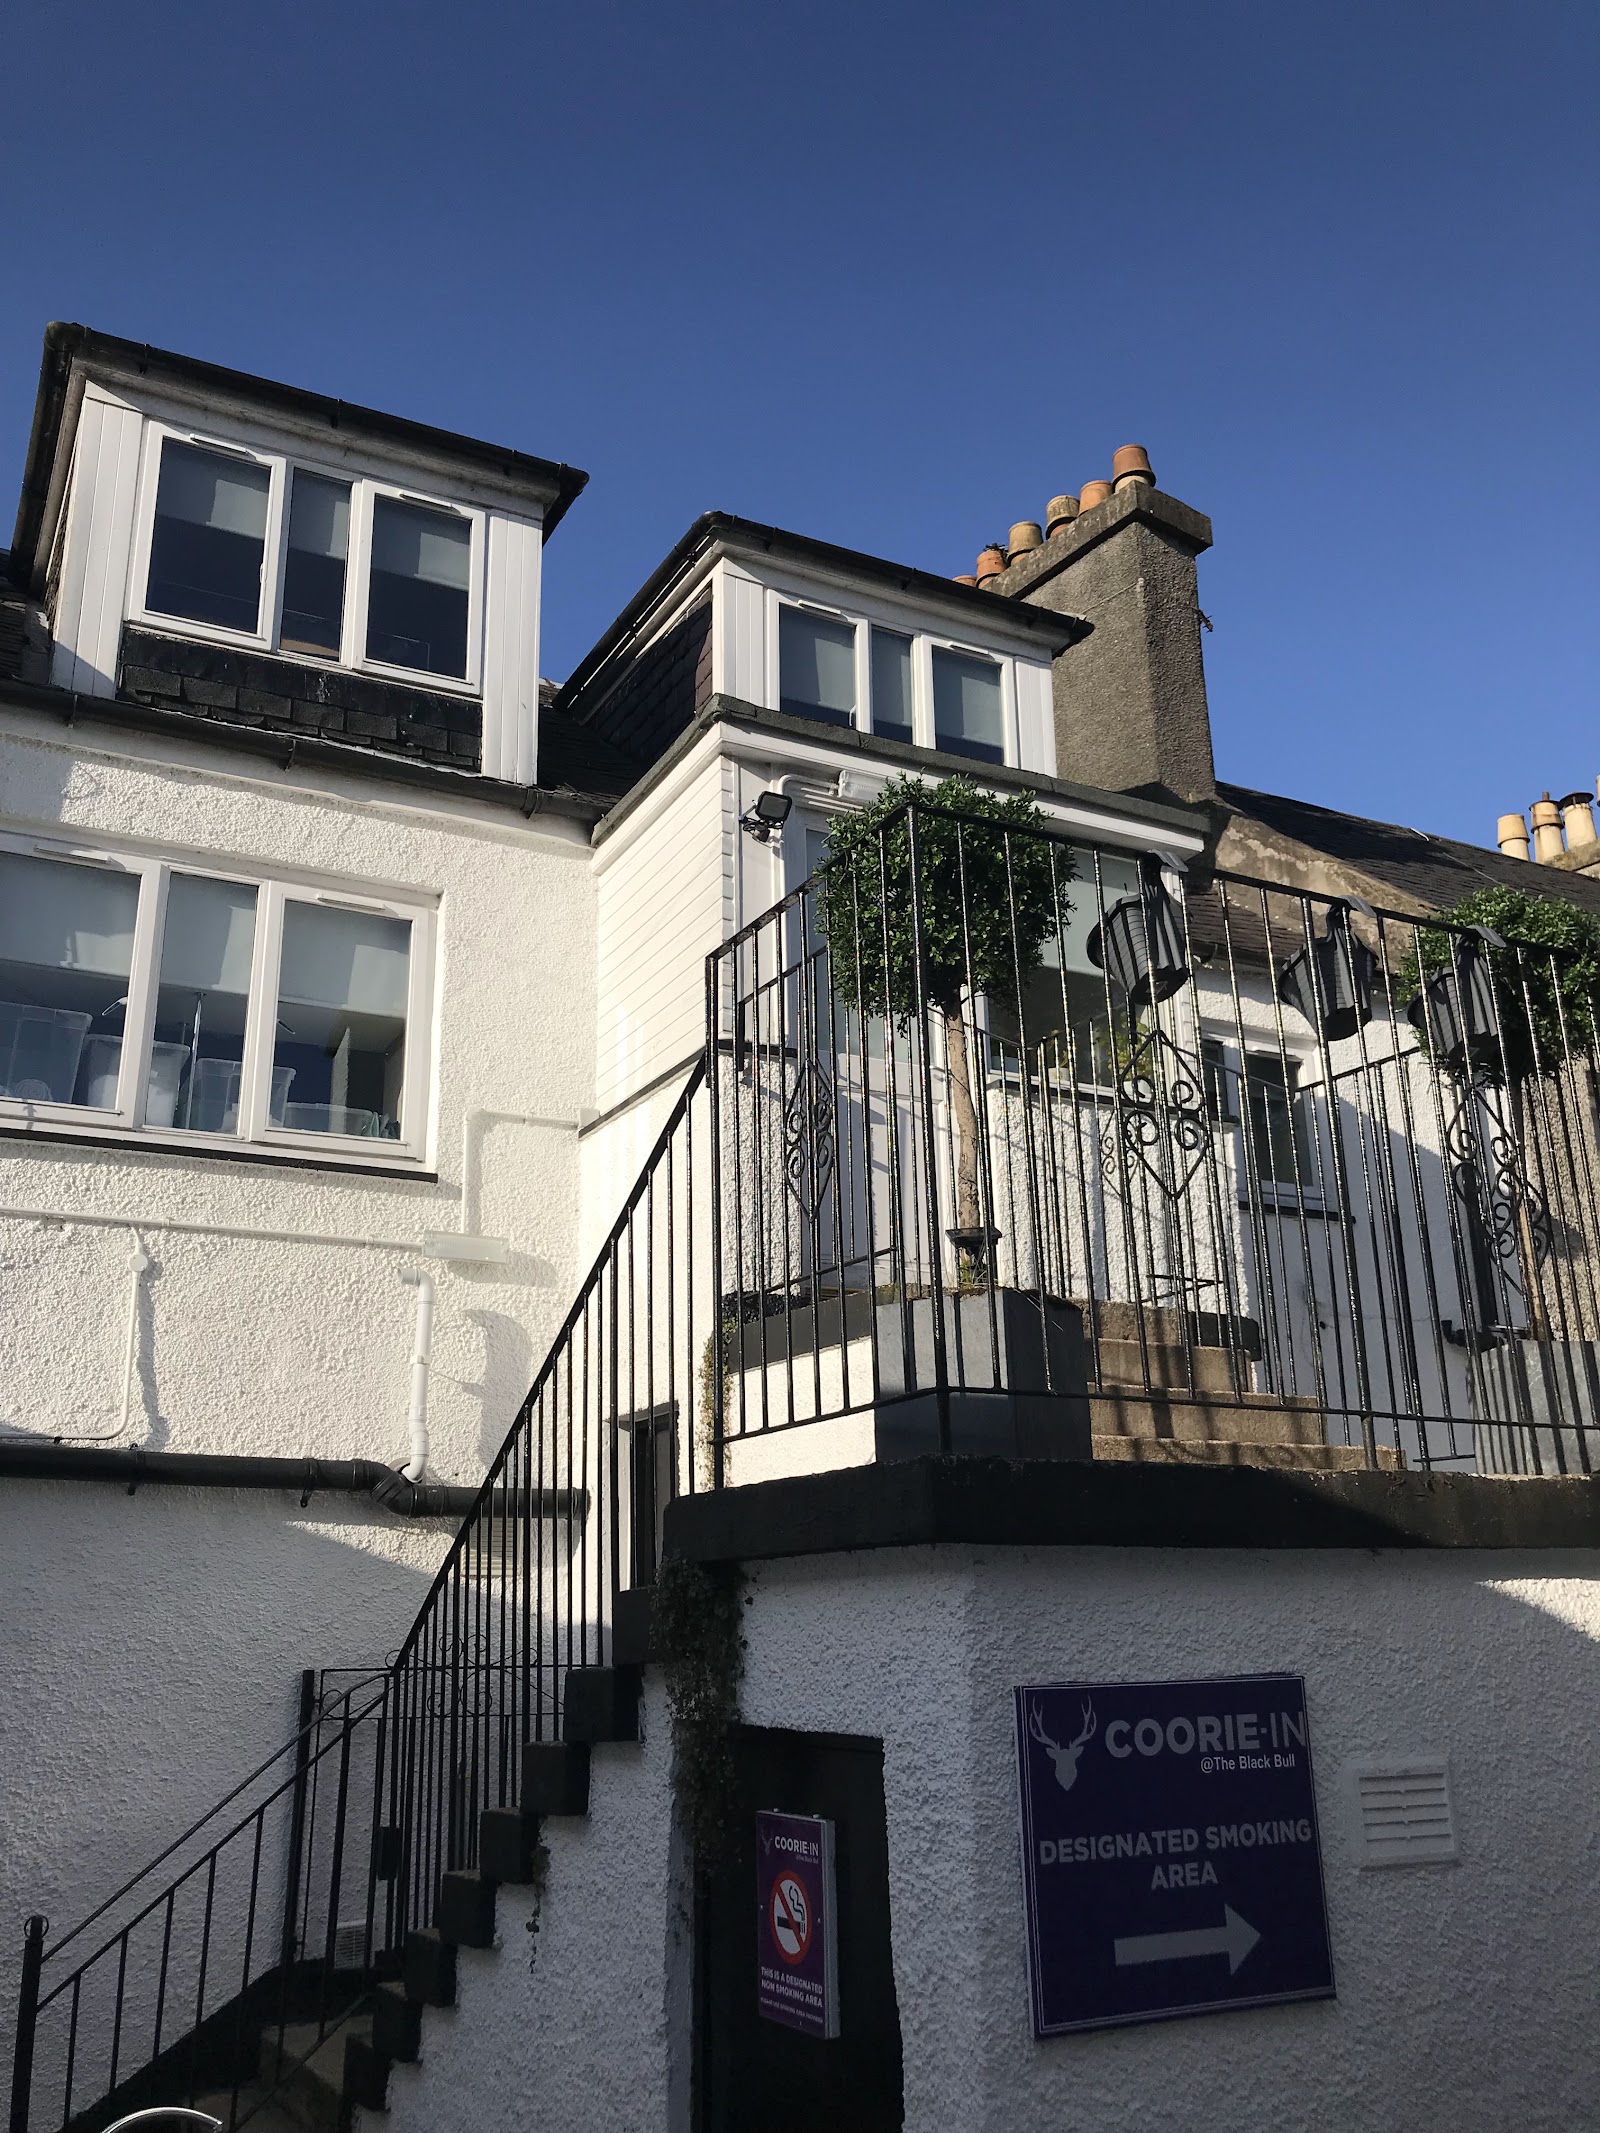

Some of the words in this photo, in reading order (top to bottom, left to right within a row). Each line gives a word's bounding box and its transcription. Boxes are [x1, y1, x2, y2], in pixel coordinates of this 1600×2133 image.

[1104, 1711, 1307, 1758] COORIE-IN
[1200, 1756, 1235, 1774] @The
[1239, 1754, 1271, 1770] Black
[1274, 1753, 1296, 1768] Bull
[775, 1836, 818, 1856] COORIE-IN
[1039, 1828, 1200, 1865] DESIGNATED
[1205, 1818, 1312, 1850] SMOKING
[1150, 1861, 1219, 1890] AREA
[761, 1966, 773, 1978] THIS
[774, 1971, 779, 1980] IS
[781, 1973, 785, 1981] A
[786, 1975, 822, 1994] DESIGNATED
[761, 1979, 775, 1992] NON
[776, 1984, 804, 2001] SMOKING
[805, 1994, 822, 2007] AREA
